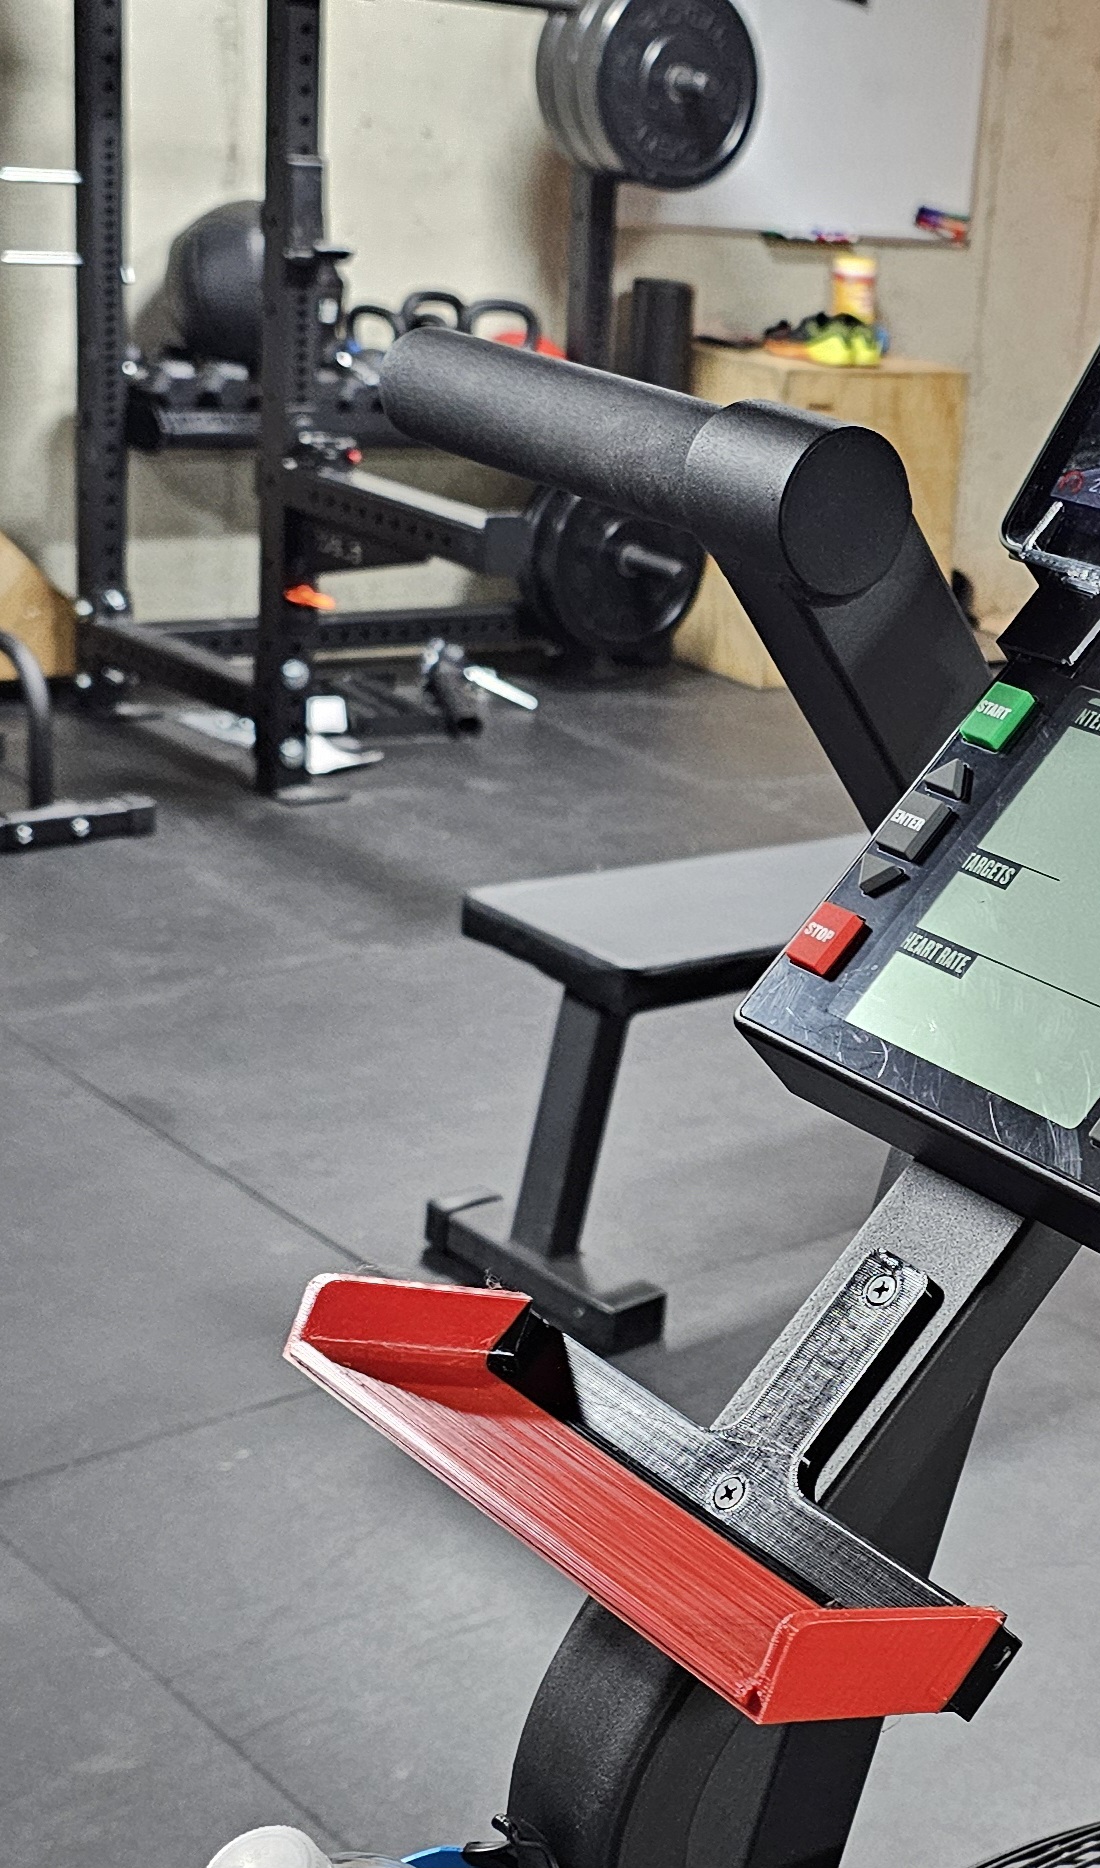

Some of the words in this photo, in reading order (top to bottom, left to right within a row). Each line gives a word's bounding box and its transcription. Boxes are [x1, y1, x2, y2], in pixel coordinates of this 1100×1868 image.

[976, 699, 1013, 721] START
[890, 808, 926, 832] ENTER
[961, 852, 1016, 885] TARGETS
[804, 922, 836, 943] STOP
[901, 931, 943, 961] HEART
[937, 947, 972, 974] RATE
